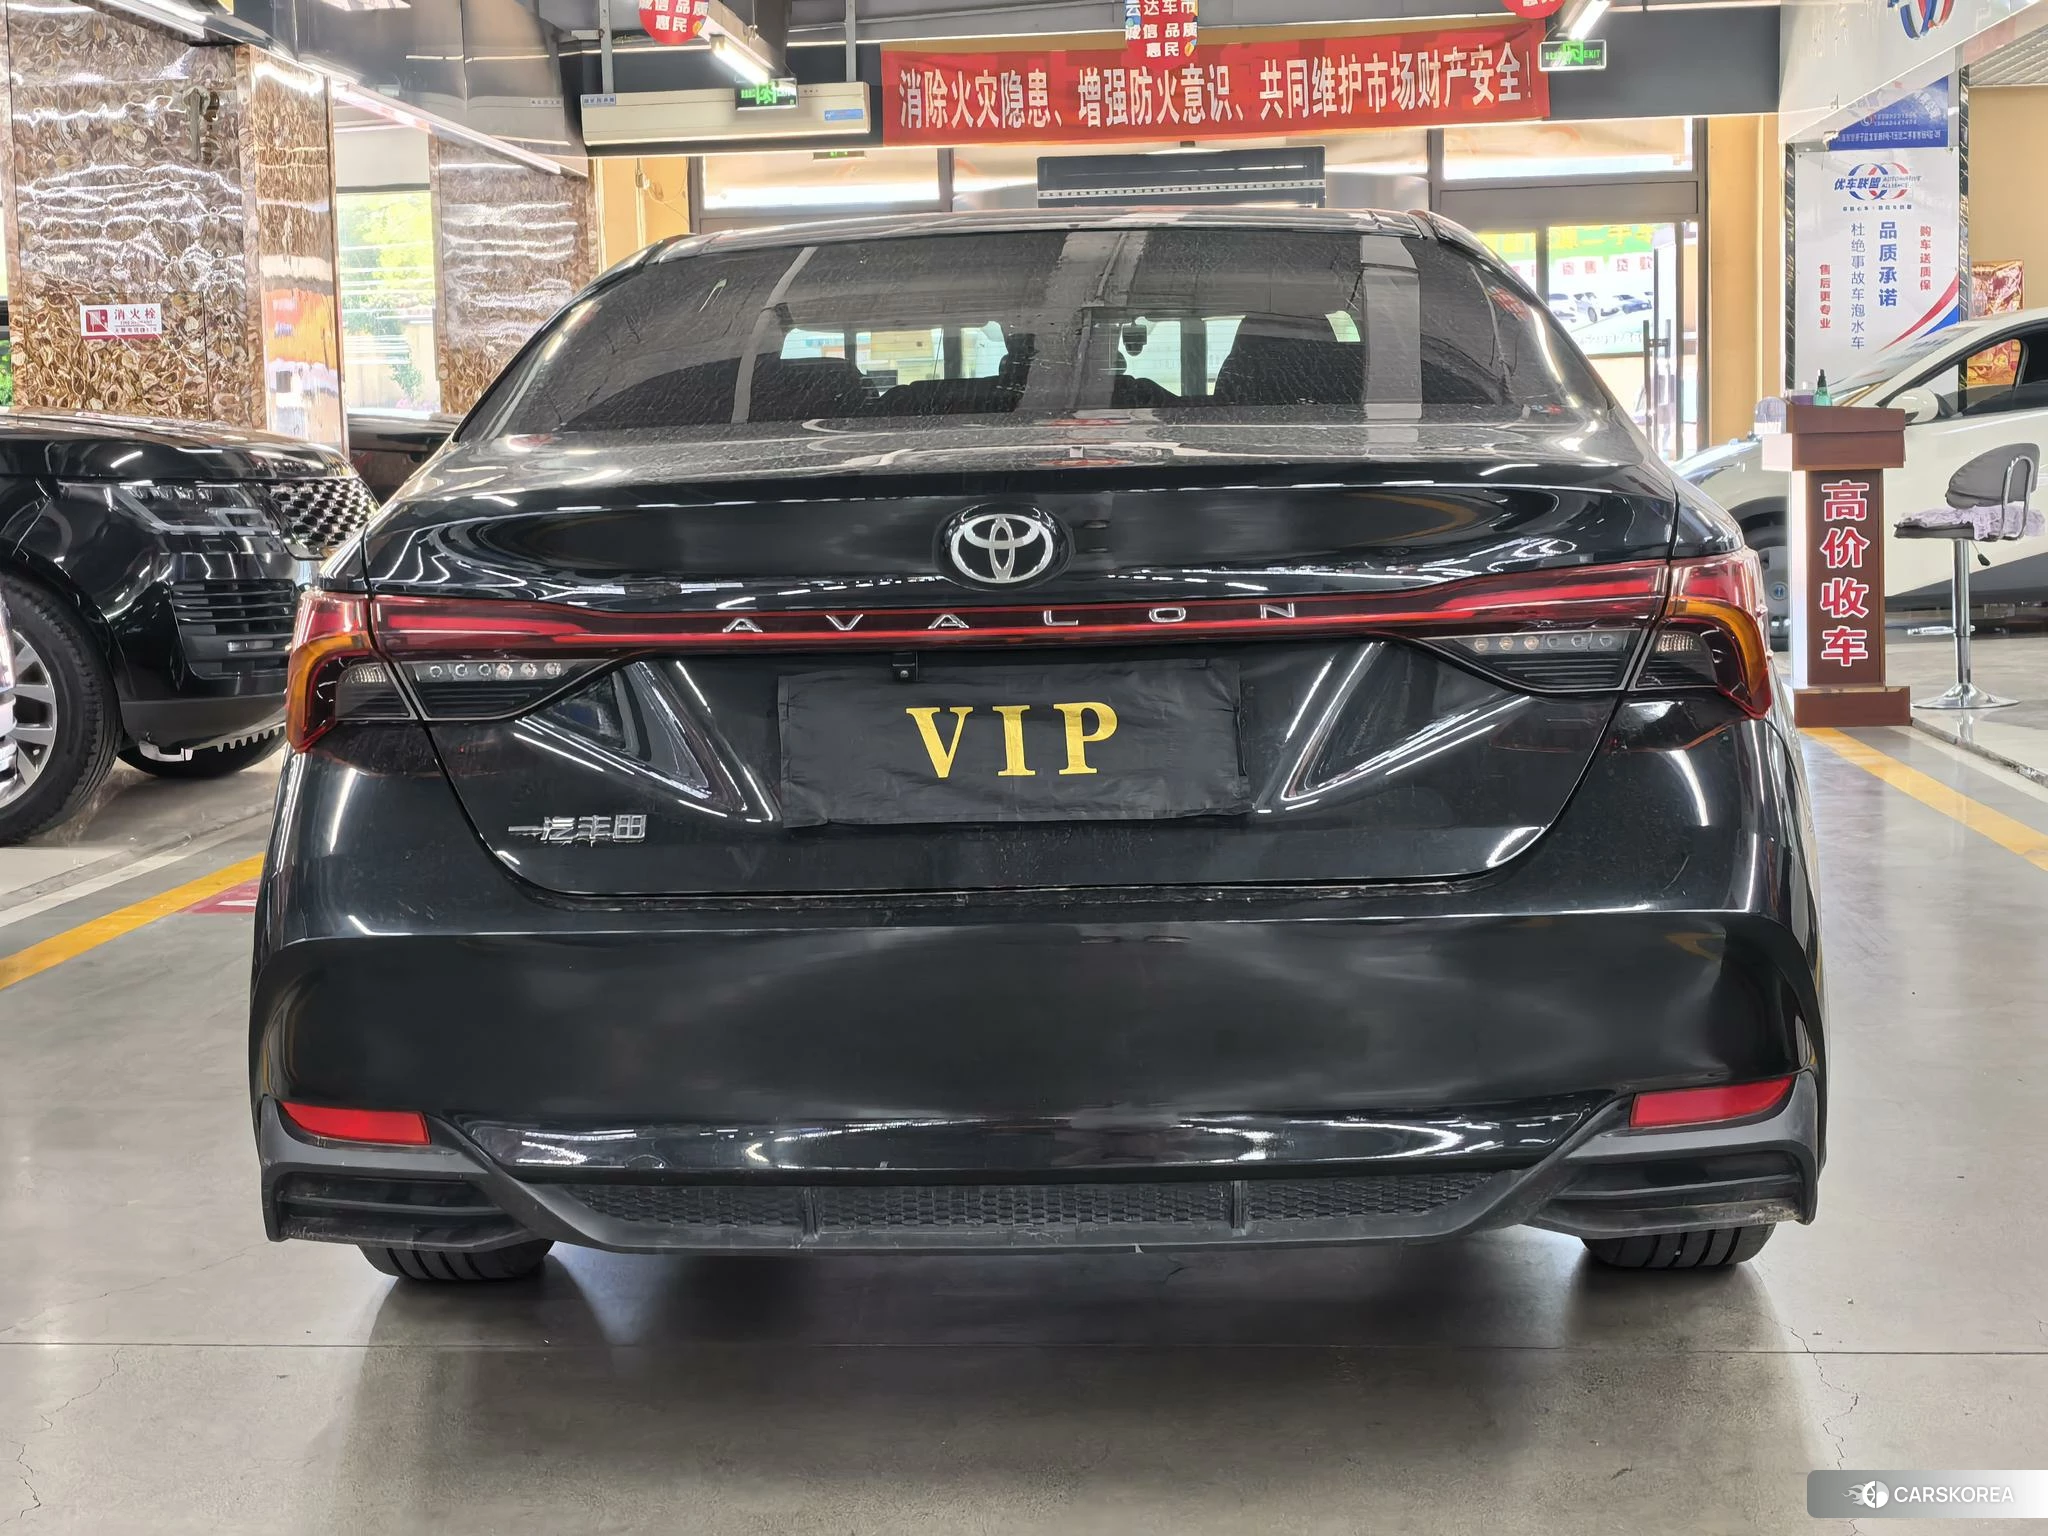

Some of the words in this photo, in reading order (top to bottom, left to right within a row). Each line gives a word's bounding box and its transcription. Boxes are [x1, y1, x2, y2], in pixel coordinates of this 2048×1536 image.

[655, 15, 688, 32] 惠民
[1165, 22, 1197, 38] 品质
[1146, 42, 1179, 57] 惠民
[1834, 176, 1881, 190] 优车联盟
[1879, 221, 1898, 307] 品质承诺
[1919, 225, 1932, 291] 购车送质保
[1819, 263, 1831, 329] 售后更专业
[1850, 222, 1865, 350] 杜绝事故车泡水车
[114, 307, 156, 321] 消火栓
[1820, 479, 1871, 667] 高价收车
[722, 603, 1296, 634] AVALON
[905, 702, 1118, 779] VIP
[507, 814, 648, 842] 一汽丰田
